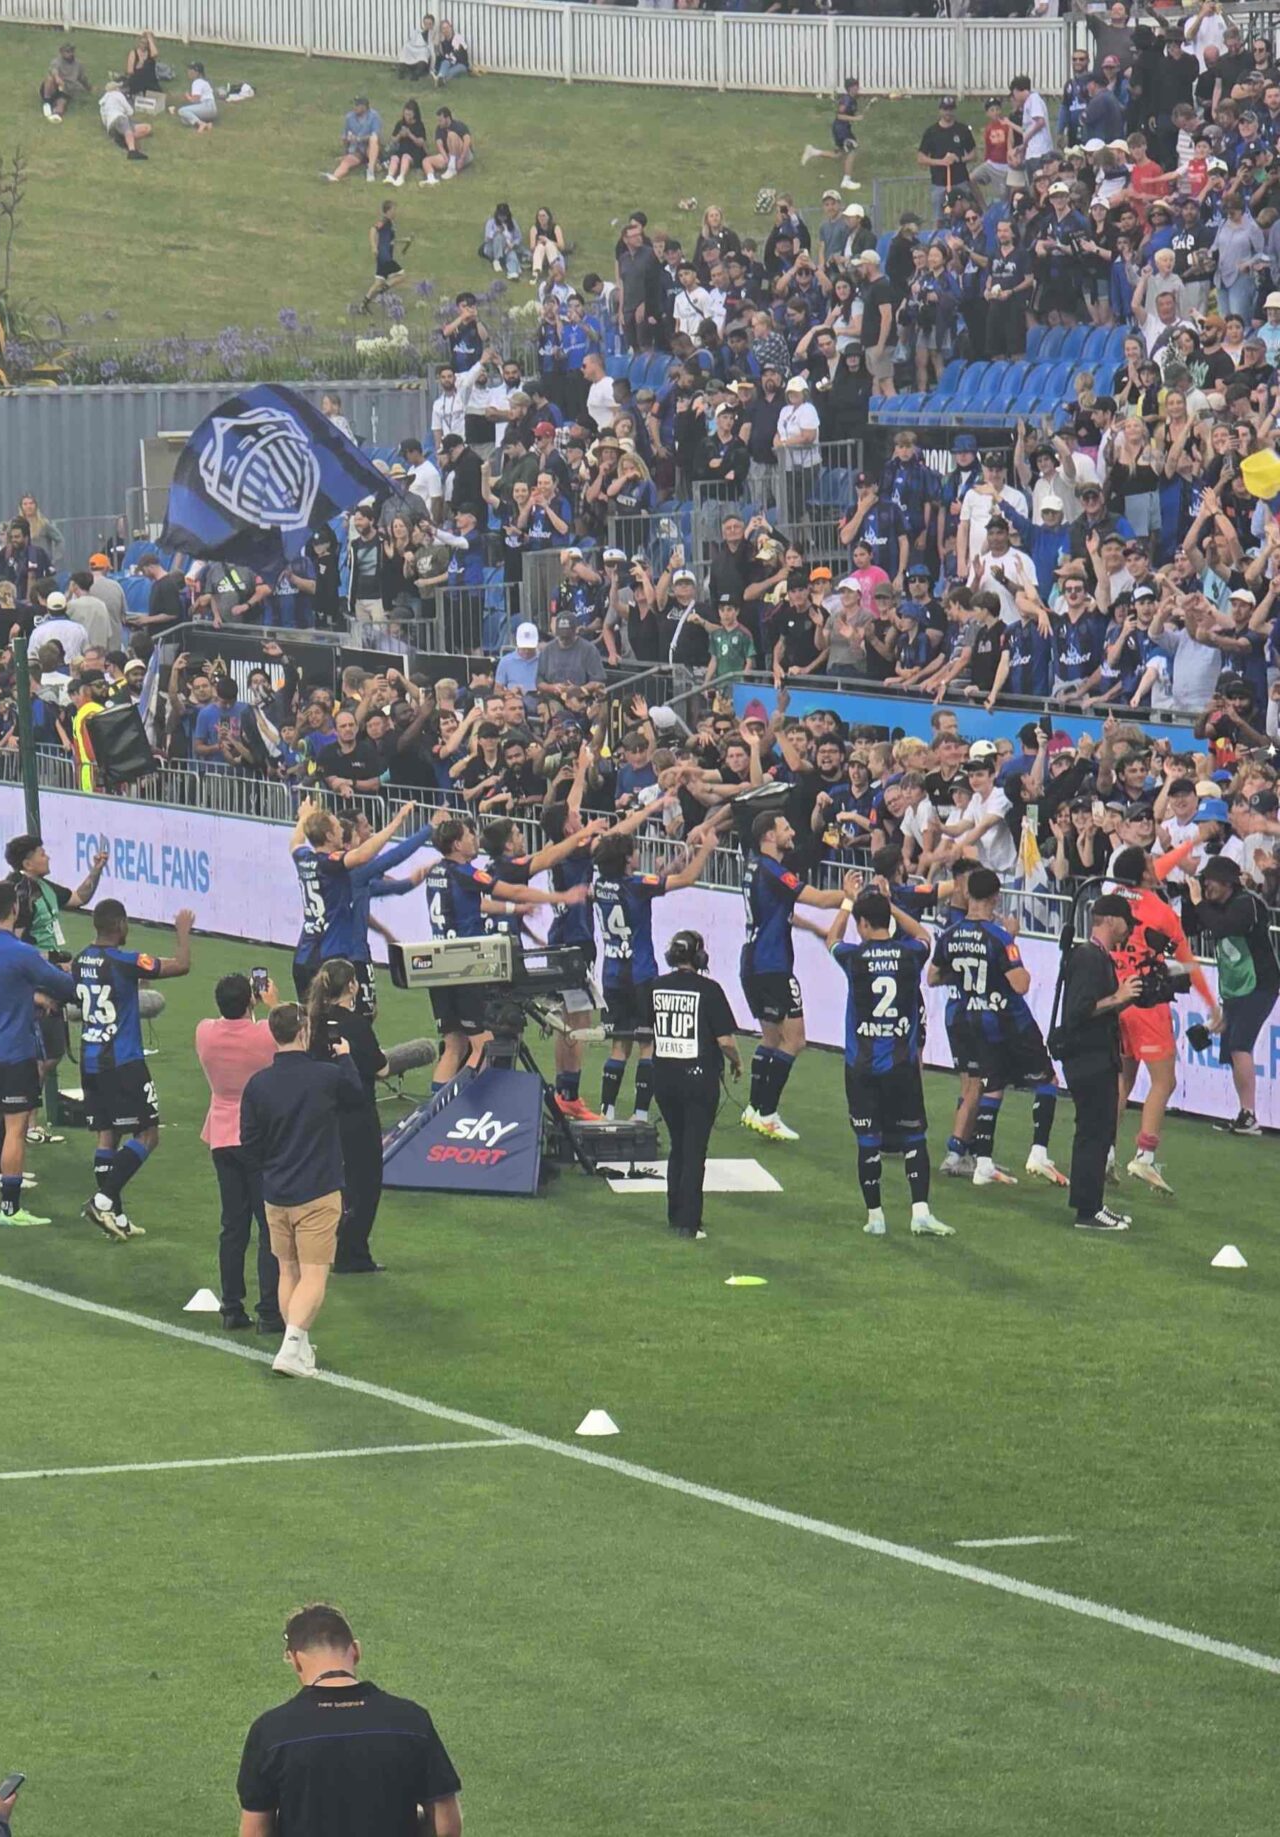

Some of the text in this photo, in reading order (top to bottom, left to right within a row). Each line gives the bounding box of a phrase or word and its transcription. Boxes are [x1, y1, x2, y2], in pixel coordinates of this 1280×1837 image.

[721, 643, 729, 656] 9
[1059, 652, 1092, 666] Anchor
[115, 838, 159, 885] REAL
[161, 845, 210, 894] FANS
[430, 891, 446, 930] 4
[871, 948, 901, 959] Liberty
[80, 967, 98, 979] HALL
[868, 960, 898, 972] SAKAI
[788, 978, 801, 998] 5
[871, 976, 899, 1018] 2
[75, 983, 117, 1024] 23
[654, 994, 695, 1013] SWITCH
[655, 1013, 668, 1036] IT
[671, 1014, 695, 1037] UP
[856, 1021, 894, 1037] ANZ
[446, 1111, 519, 1147] sky
[426, 1144, 508, 1165] SPORT
